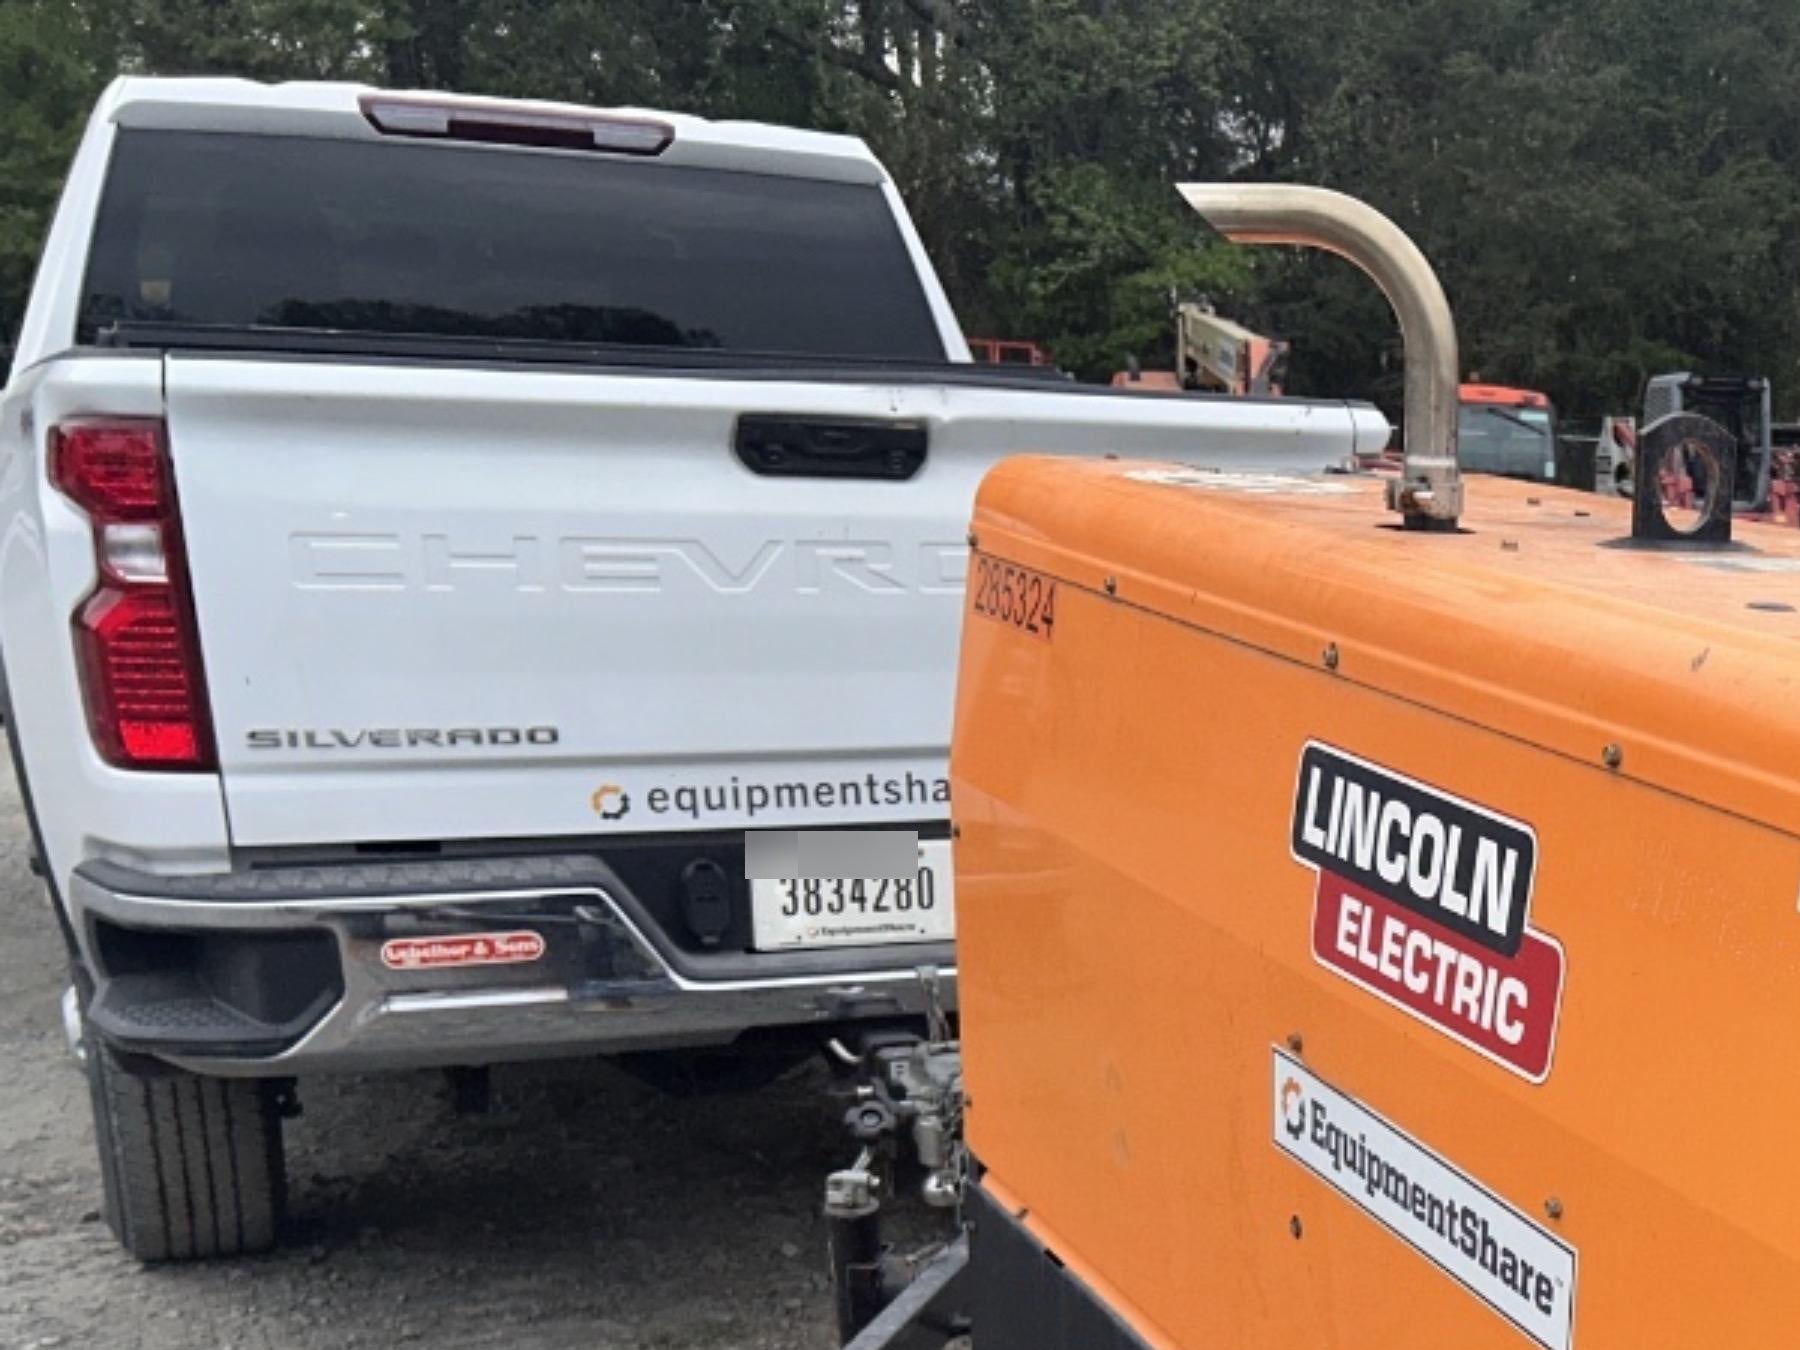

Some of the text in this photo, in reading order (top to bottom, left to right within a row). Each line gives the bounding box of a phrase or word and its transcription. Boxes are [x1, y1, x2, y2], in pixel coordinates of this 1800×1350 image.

[246, 725, 559, 748] SILVERADO
[778, 866, 935, 916] 3834280
[1301, 764, 1520, 937] LINCOLN
[1334, 892, 1531, 1047] ELECTRIC
[1309, 1098, 1555, 1316] EquipmentShare
